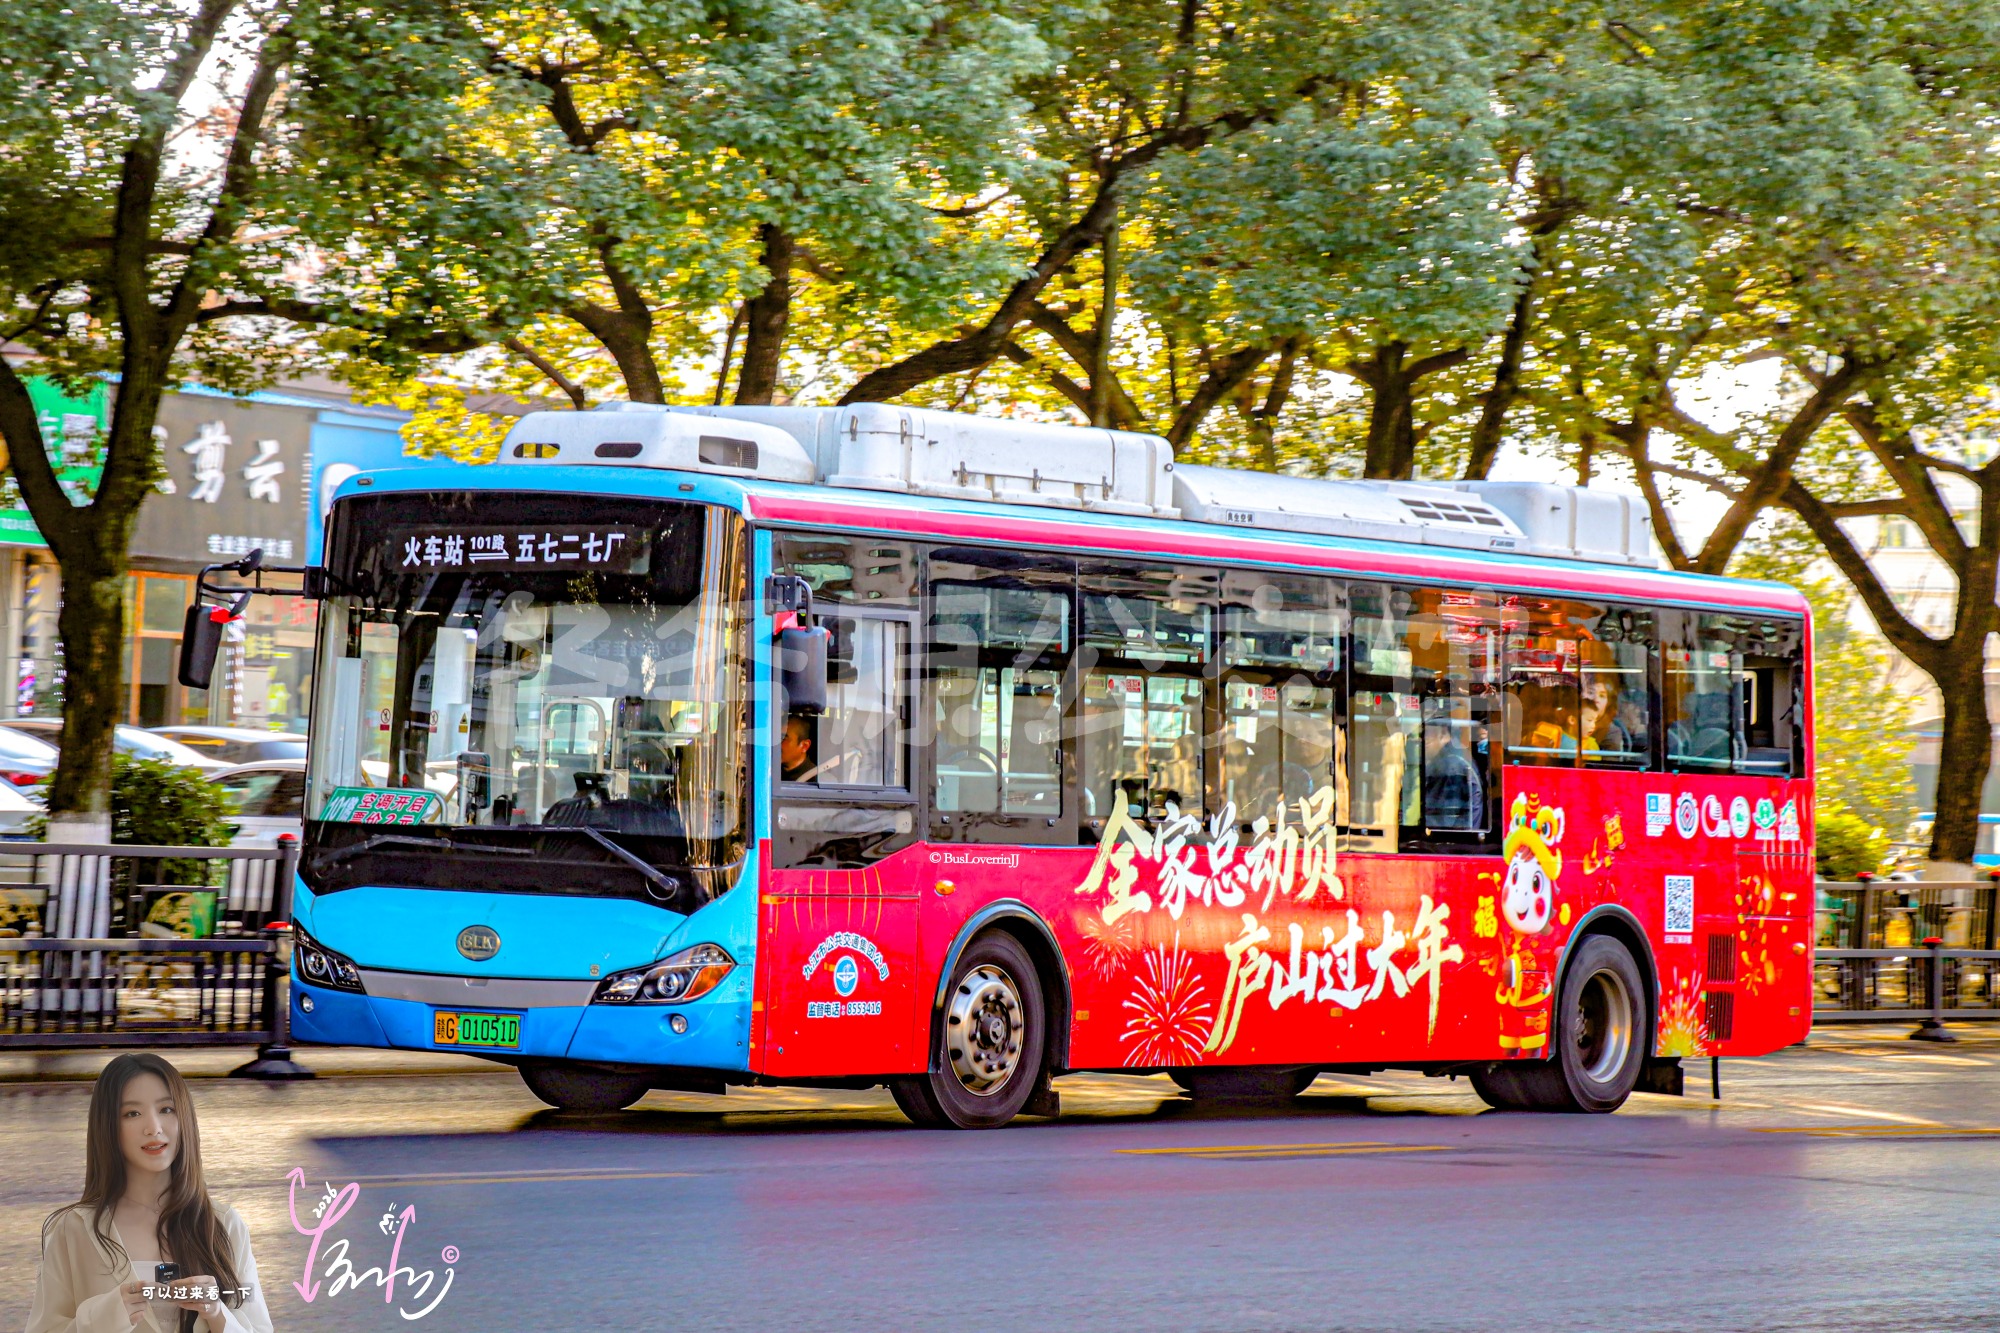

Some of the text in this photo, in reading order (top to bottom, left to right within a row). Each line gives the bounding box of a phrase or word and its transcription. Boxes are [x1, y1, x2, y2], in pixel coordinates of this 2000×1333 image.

[151, 420, 285, 503] 剪云
[402, 532, 626, 567] 火车站 101路 五七二七厂
[359, 793, 428, 812] 空调开启
[1075, 786, 1344, 926] 全家总动员
[1474, 895, 1498, 938] 福
[803, 932, 890, 981] 九江市公共交通集团公司
[1199, 895, 1464, 1057] 庐山过大年
